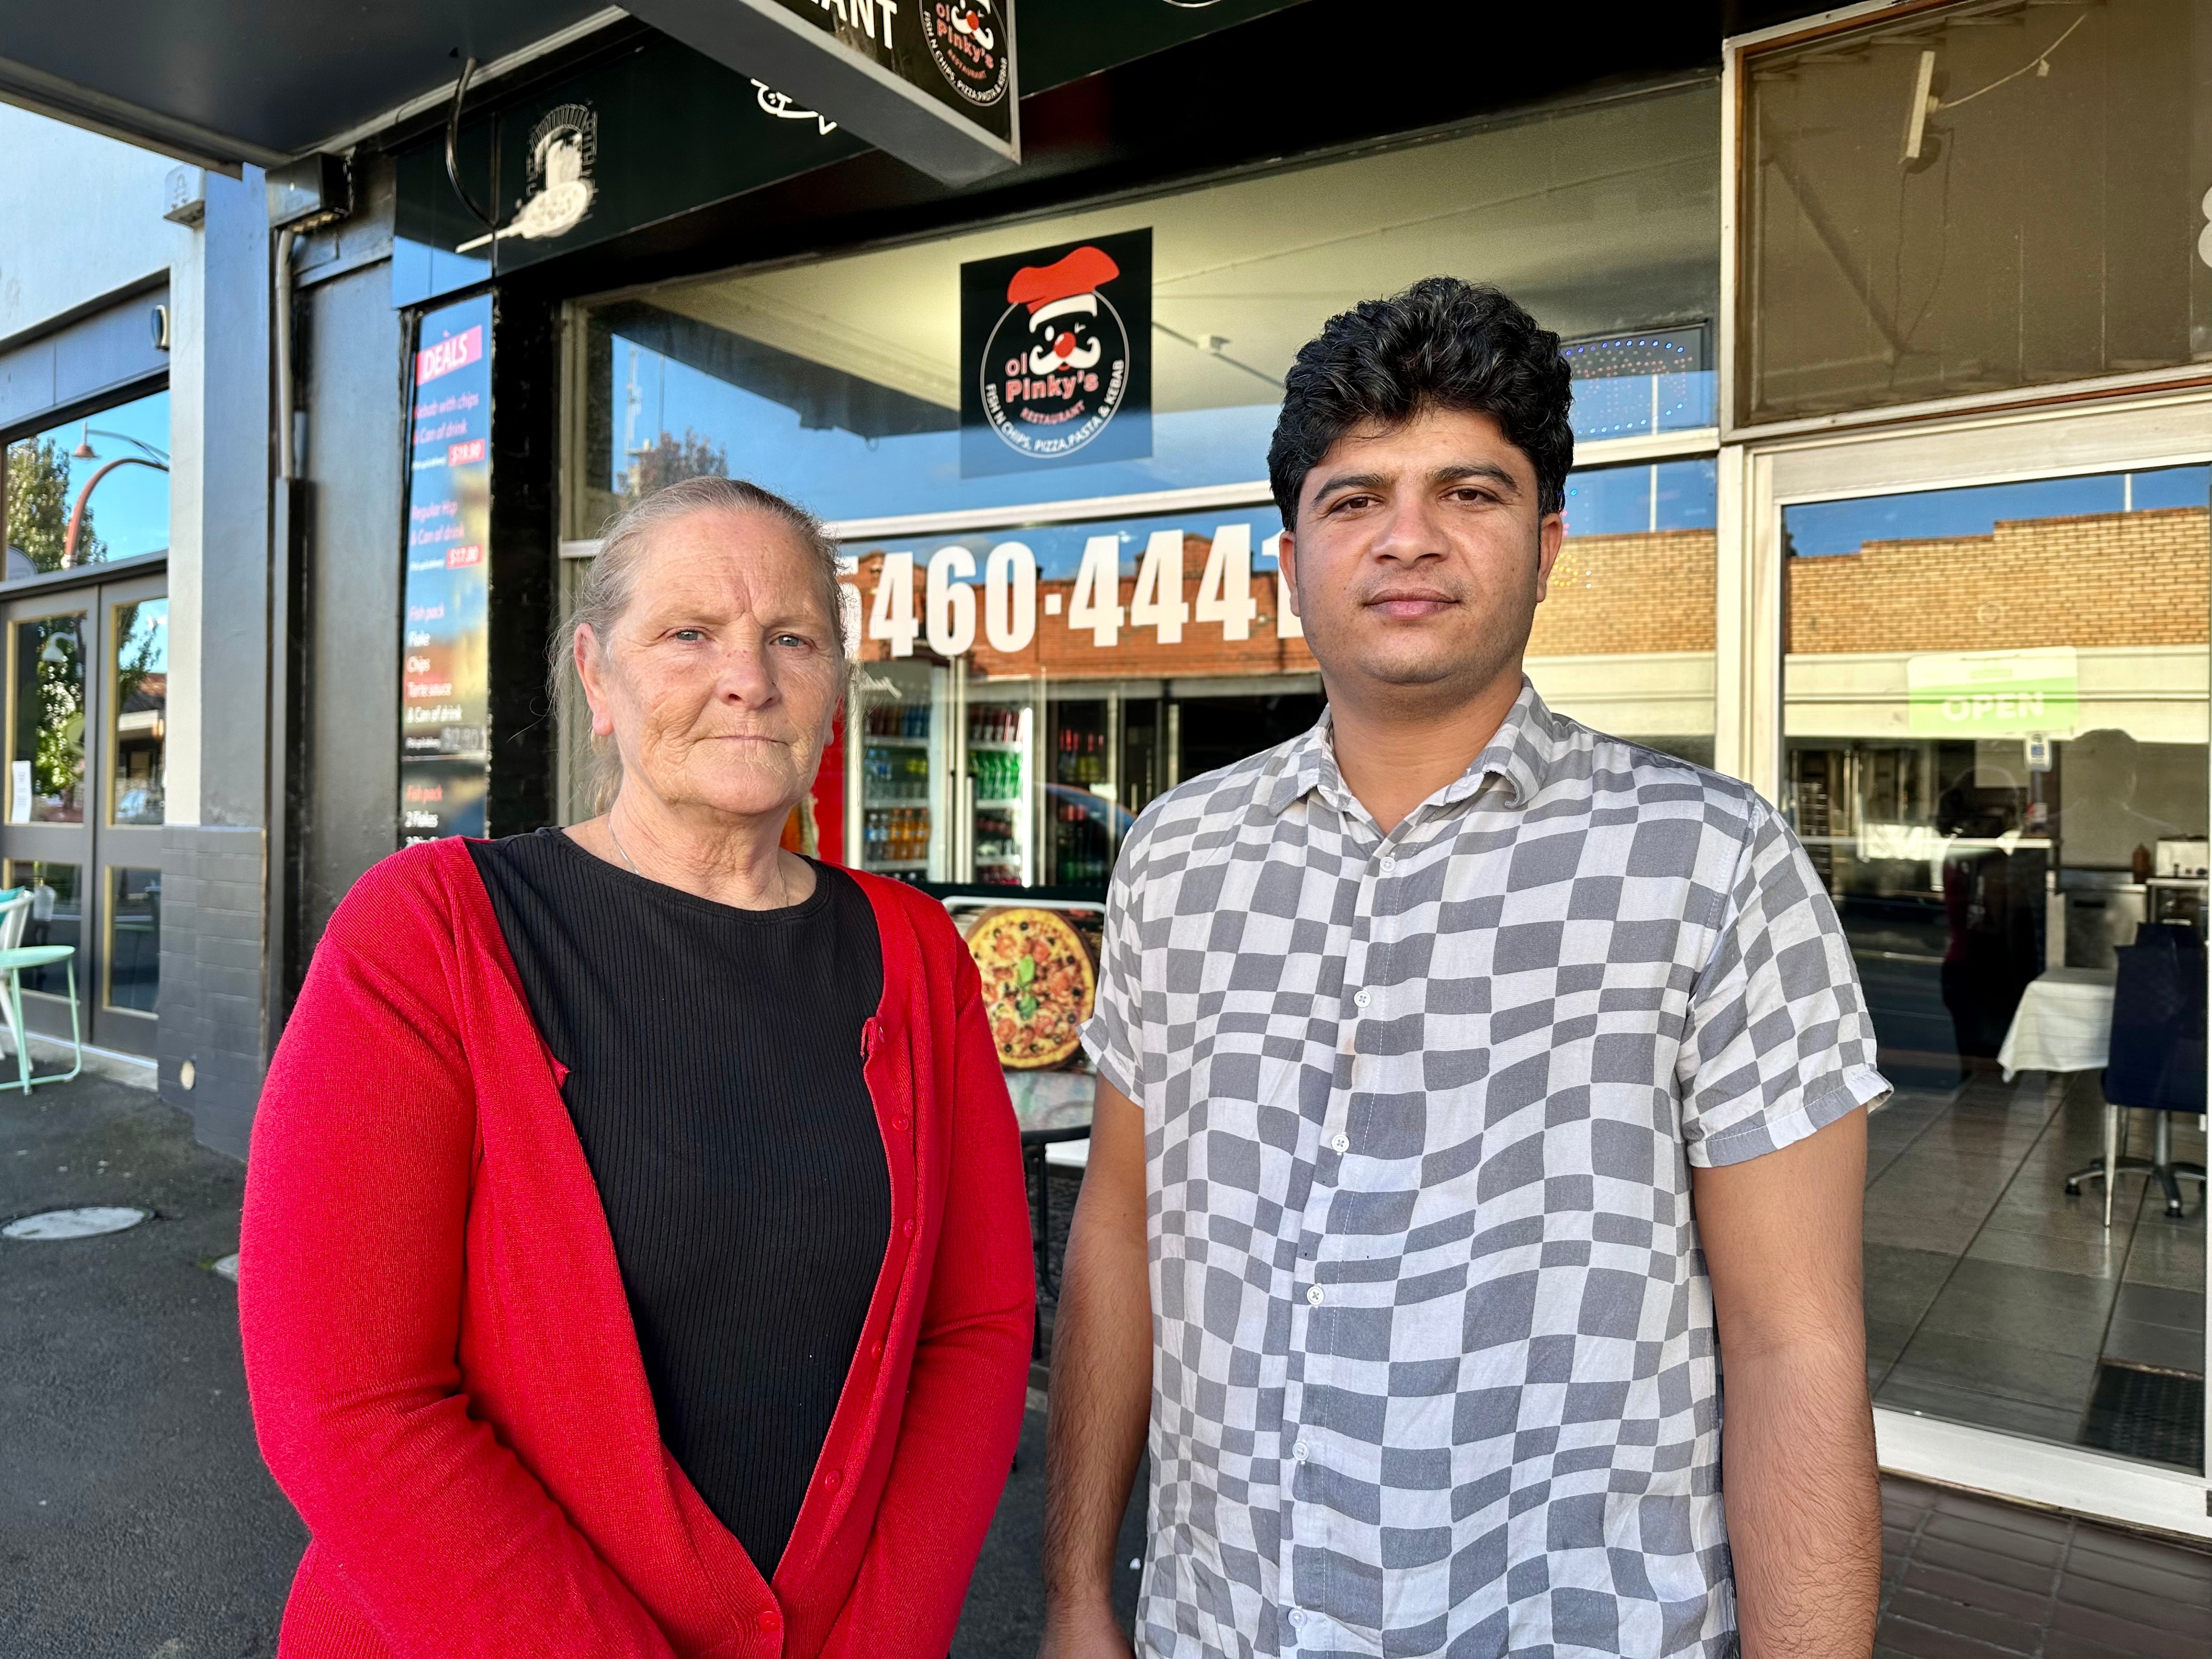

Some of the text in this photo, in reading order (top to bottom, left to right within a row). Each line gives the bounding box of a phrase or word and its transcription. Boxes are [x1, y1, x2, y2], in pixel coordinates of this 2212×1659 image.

[923, 10, 934, 37] FISH
[930, 38, 939, 49] N
[936, 18, 994, 69] Pinky's
[423, 332, 468, 379] DEALS
[1005, 369, 1099, 403] Pinky's
[1104, 359, 1125, 405] KEBAB
[985, 383, 1001, 414] FISH
[1019, 399, 1085, 425] RESTAURANT
[1098, 405, 1111, 417] &
[994, 410, 1007, 425] N
[1001, 421, 1032, 450] CHIPS,
[1940, 691, 2044, 723] OPEN
